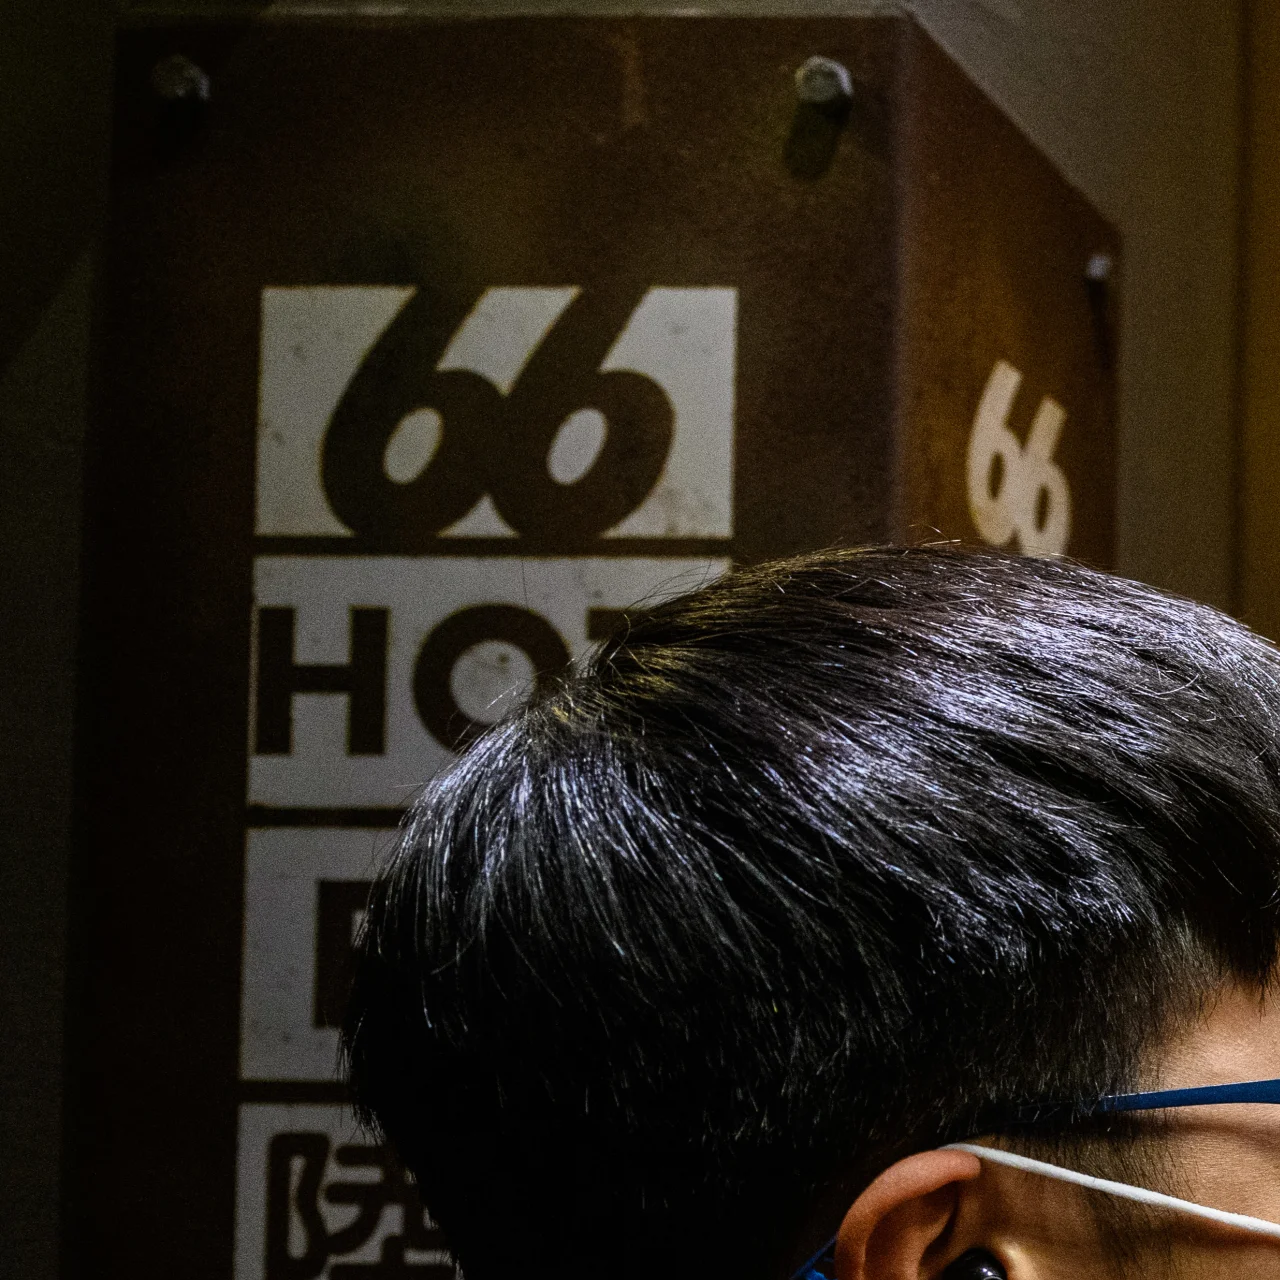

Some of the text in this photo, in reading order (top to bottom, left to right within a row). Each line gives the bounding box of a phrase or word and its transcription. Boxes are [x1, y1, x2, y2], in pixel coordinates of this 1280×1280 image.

[322, 286, 676, 538] 66
[967, 359, 1072, 558] 66
[256, 602, 648, 756] HO
